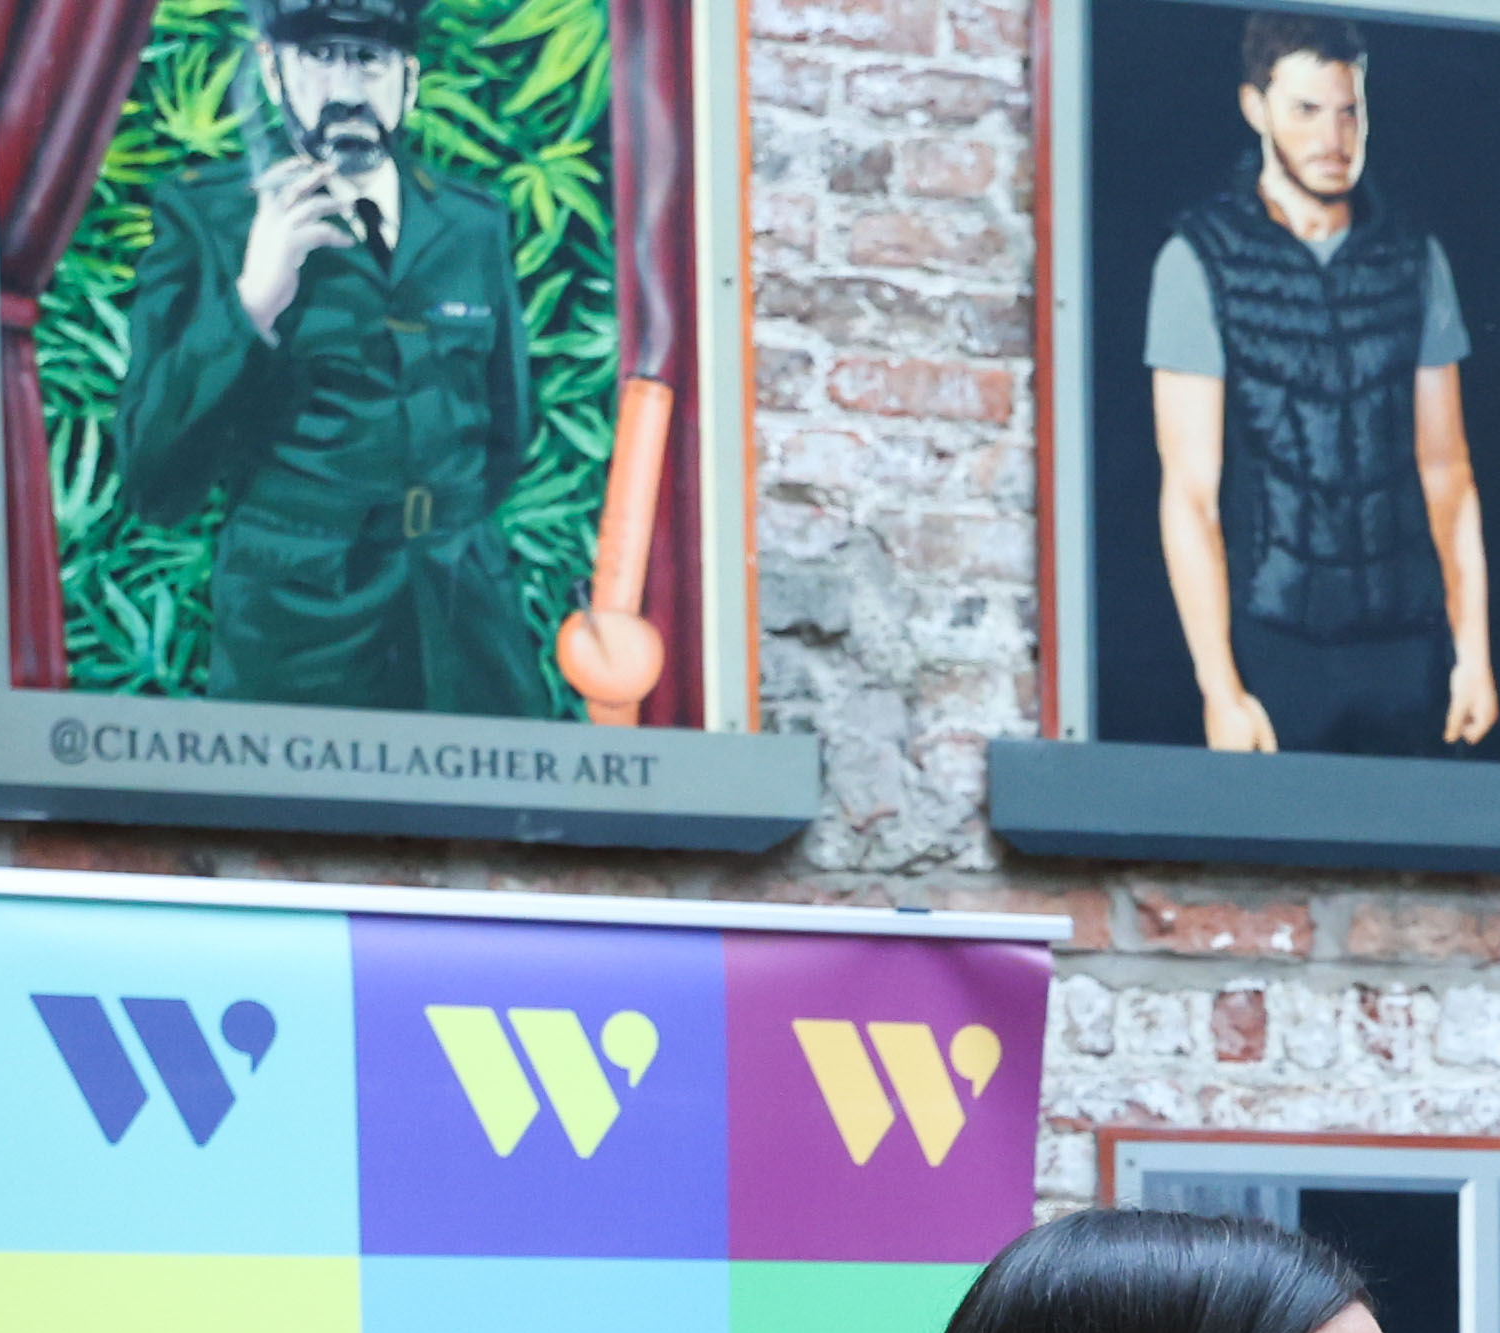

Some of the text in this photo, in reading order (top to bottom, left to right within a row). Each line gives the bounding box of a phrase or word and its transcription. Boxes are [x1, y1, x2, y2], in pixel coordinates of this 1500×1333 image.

[49, 718, 660, 788] @CIARAN GALLAGHER ART
